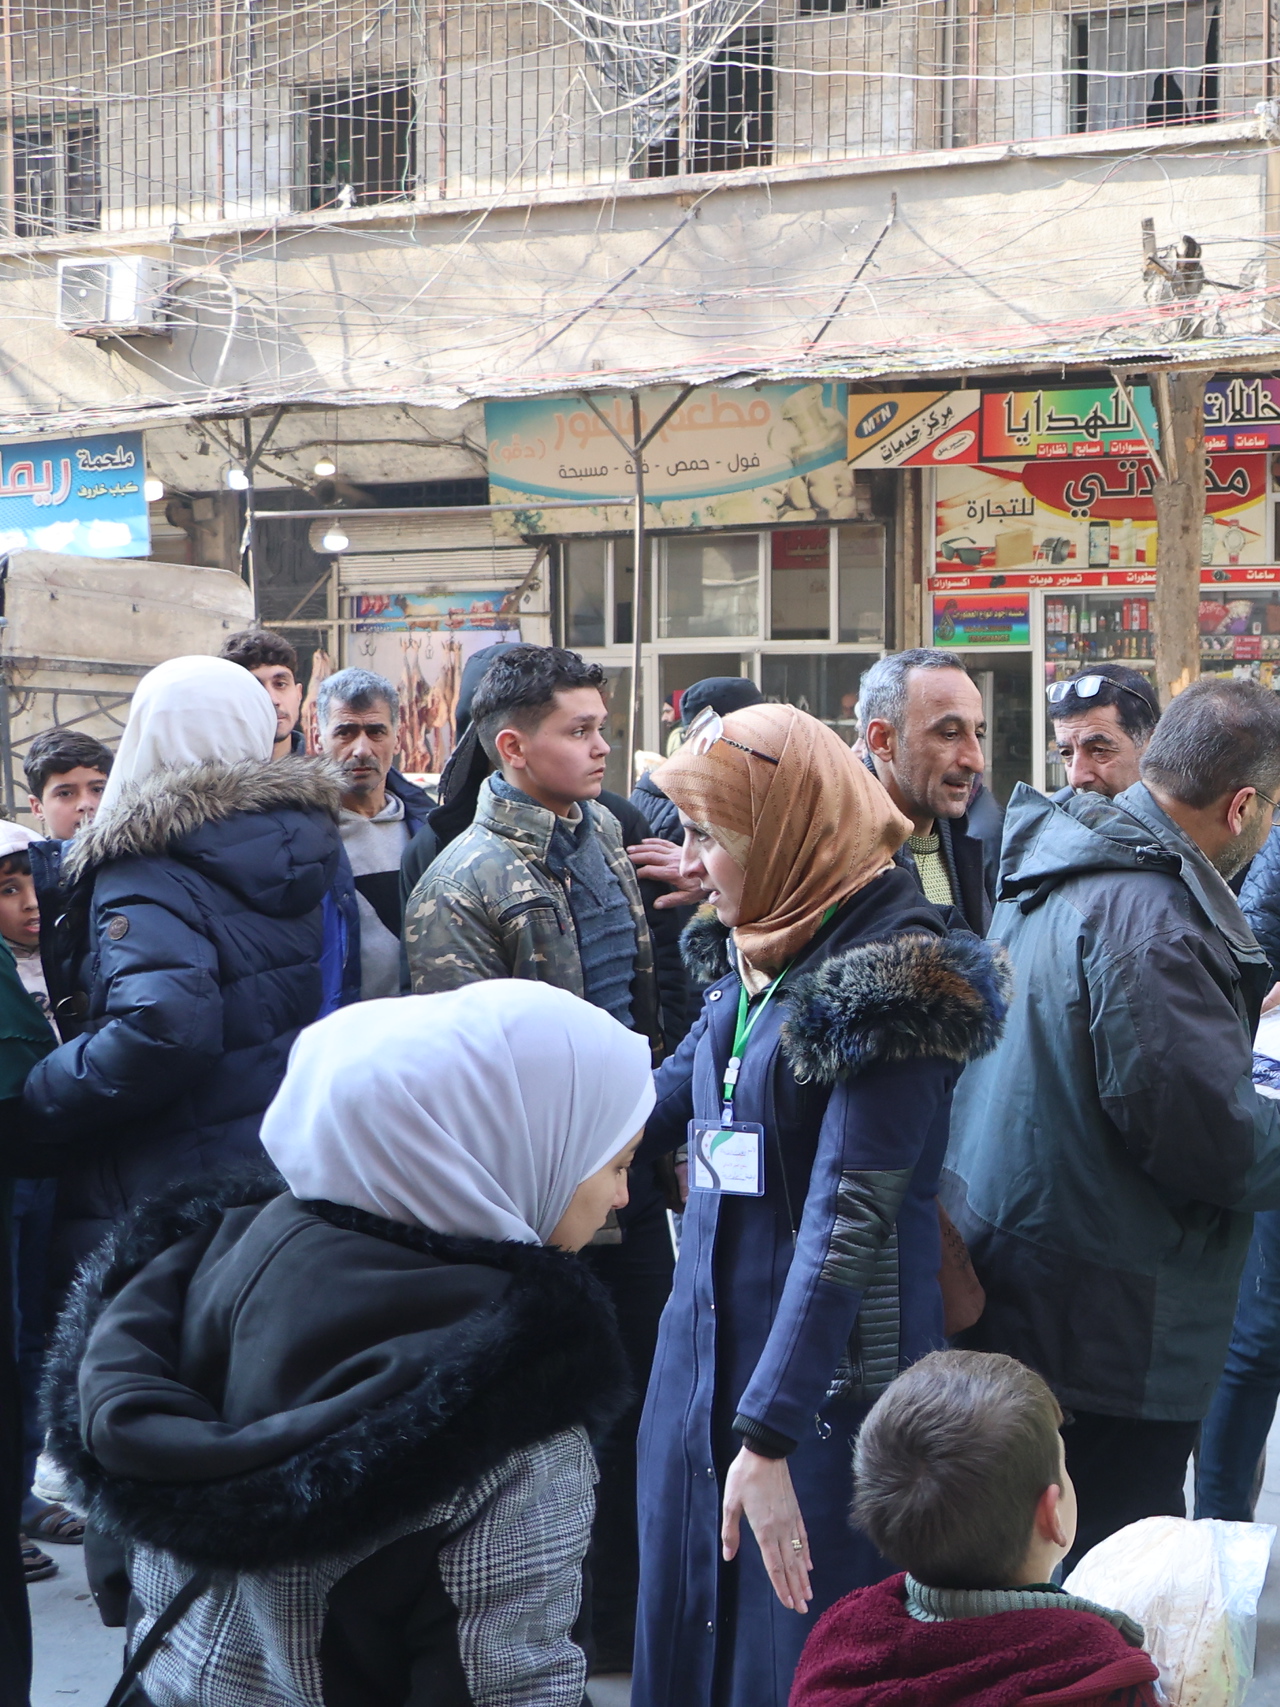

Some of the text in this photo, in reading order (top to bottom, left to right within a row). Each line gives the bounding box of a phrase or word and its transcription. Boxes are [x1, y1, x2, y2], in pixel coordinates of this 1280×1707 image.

[659, 392, 772, 443] مطعم
[862, 404, 892, 435] MTN
[881, 406, 953, 461] مركز خدمات
[1235, 436, 1266, 447] ساعات
[76, 445, 135, 471] ملحمة
[1038, 444, 1067, 457] نظارات
[666, 456, 711, 476] حمص
[727, 452, 761, 474] فول
[558, 464, 609, 481] مسبحة
[77, 482, 138, 498] كباب خاروف
[966, 496, 1036, 524] للتجارة
[1028, 575, 1053, 587] هويات
[1057, 574, 1083, 586] تصوير
[1246, 569, 1275, 580] ساعات
